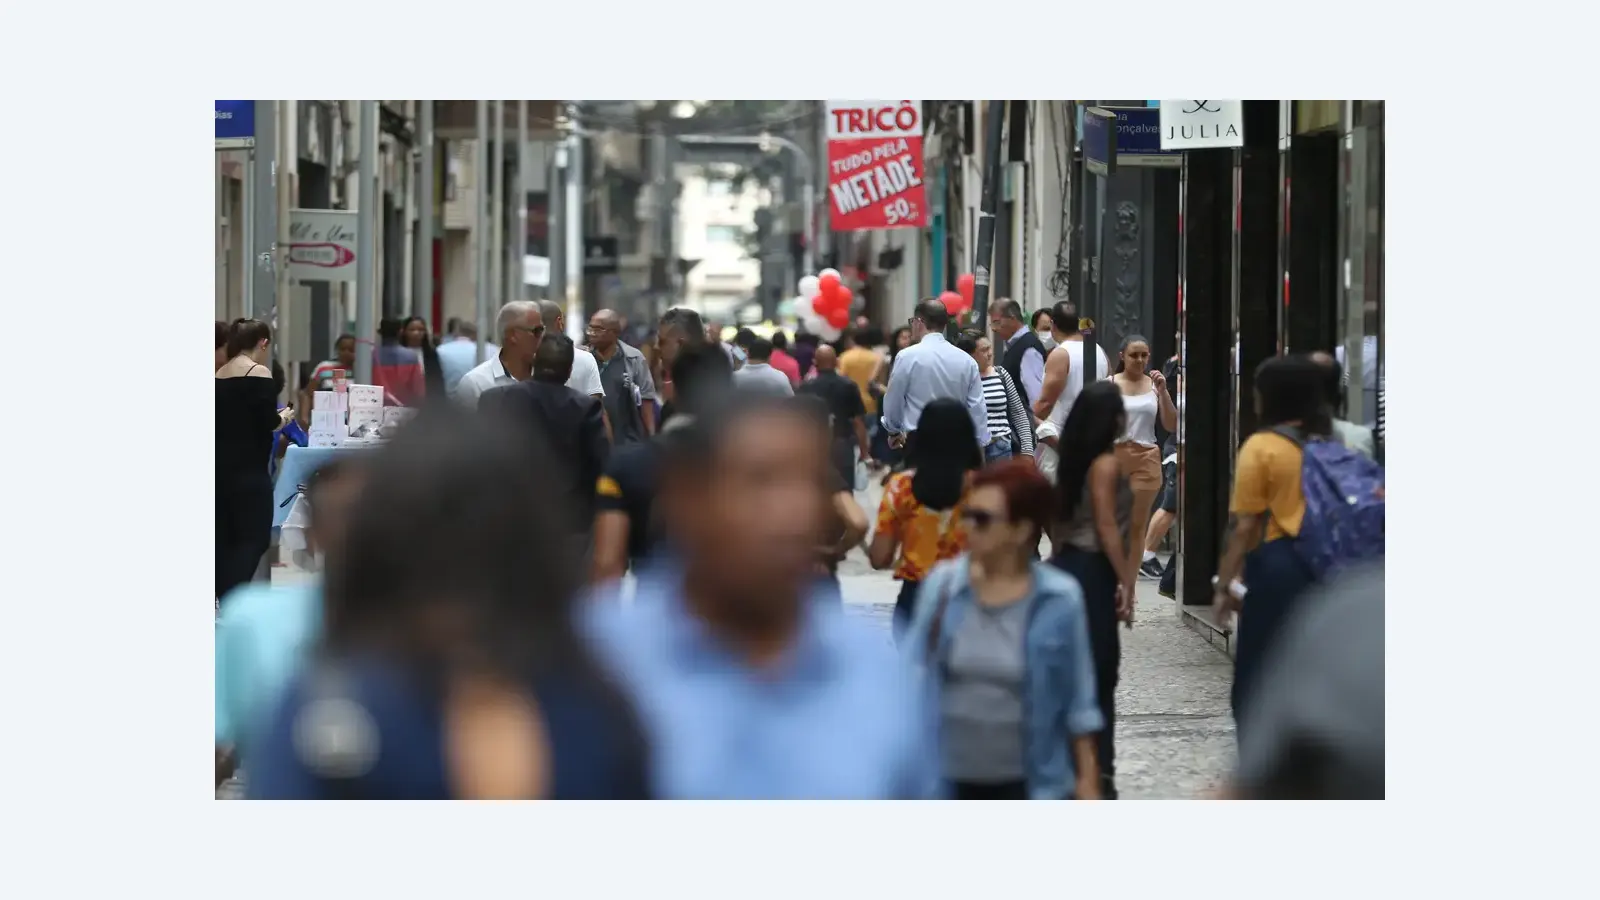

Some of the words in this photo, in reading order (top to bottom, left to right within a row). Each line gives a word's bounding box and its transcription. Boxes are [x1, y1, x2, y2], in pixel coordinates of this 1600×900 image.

[831, 100, 918, 133] TRICÔ
[1116, 123, 1160, 136] onçalve
[1166, 123, 1239, 140] JULIA
[832, 150, 872, 174] TUDO
[873, 138, 909, 160] PELA
[830, 154, 922, 215] METADE
